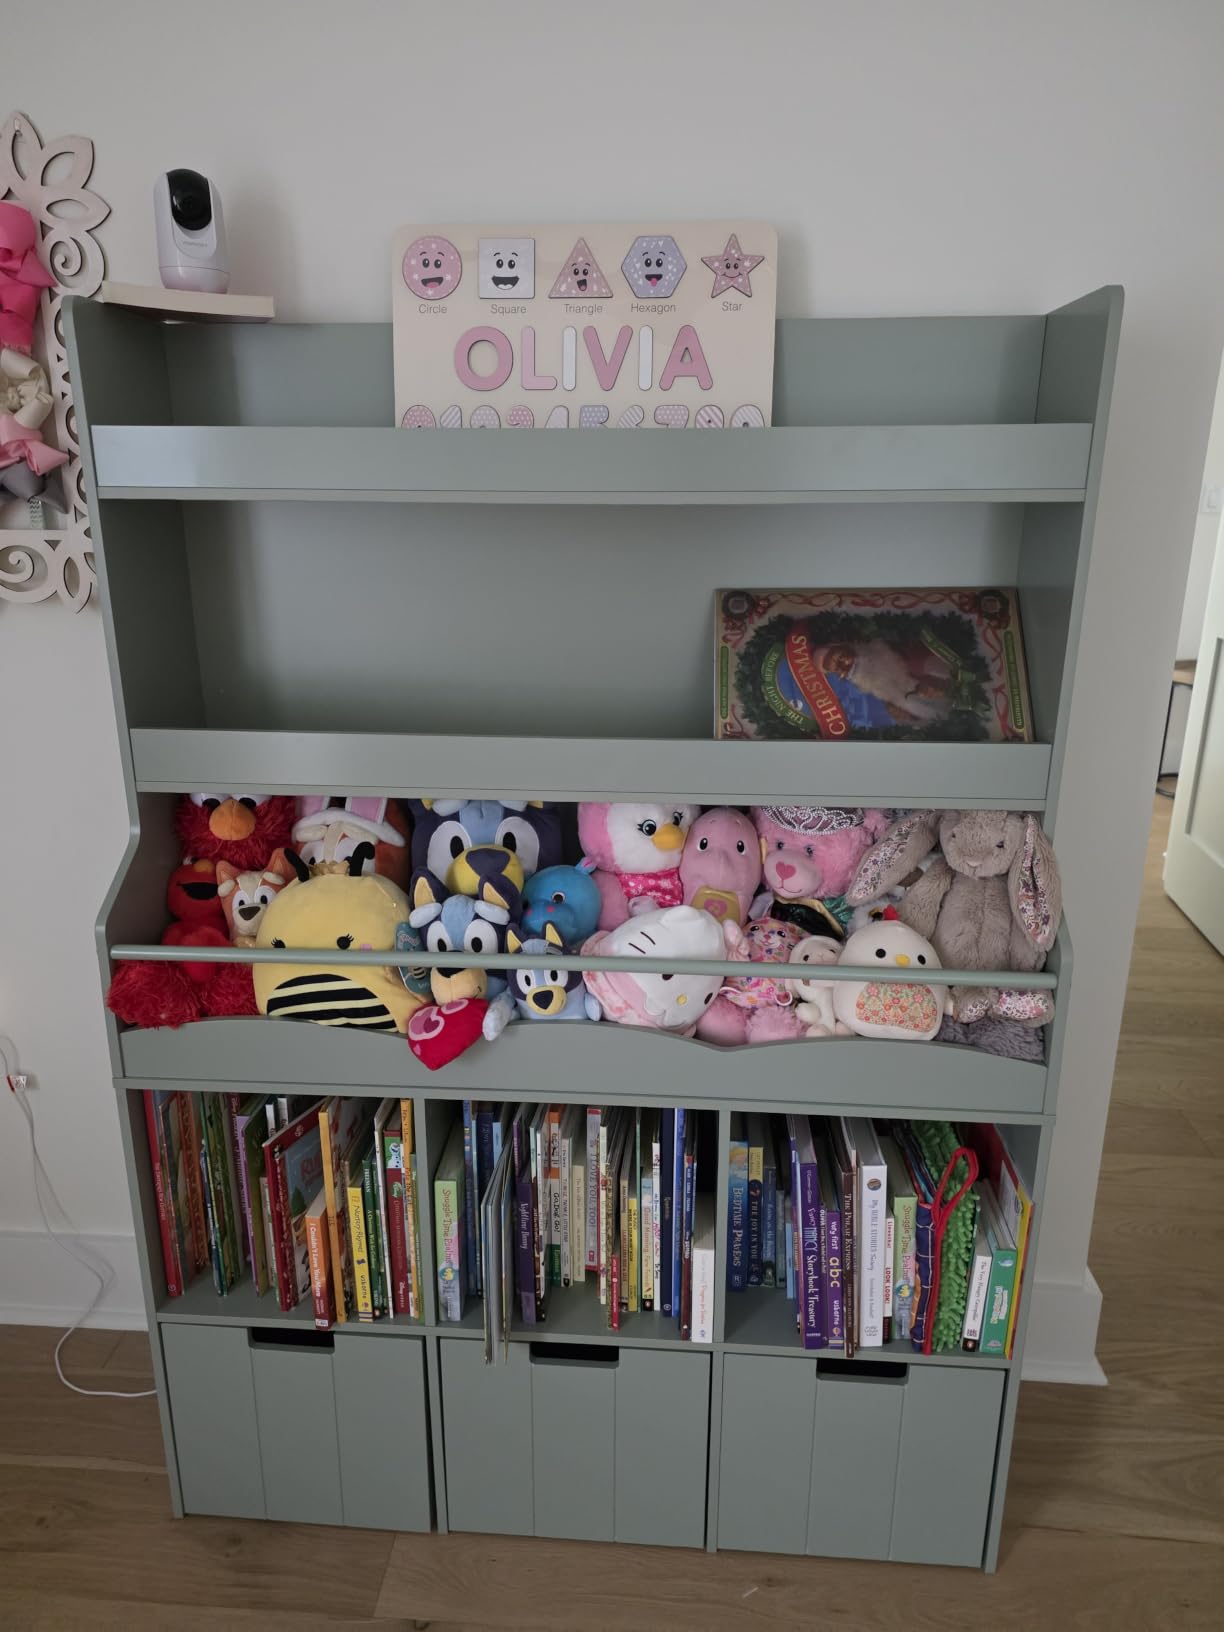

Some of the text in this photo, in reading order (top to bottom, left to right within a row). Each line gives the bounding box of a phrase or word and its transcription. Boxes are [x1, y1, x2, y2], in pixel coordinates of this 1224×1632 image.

[418, 303, 447, 314] Circle
[490, 303, 526, 316] Square
[563, 303, 603, 315] Triangle
[631, 303, 677, 315] Hexagon
[721, 301, 742, 312] Star
[454, 324, 714, 392] OLIVIA
[791, 634, 846, 735] CHRISTMAS
[766, 685, 785, 711] NIGHT
[785, 709, 804, 725] THE
[843, 1193, 851, 1209] THE
[588, 1206, 596, 1226] TOO!
[844, 1211, 852, 1236] POLAR
[870, 1209, 878, 1226] BIBLE
[352, 1204, 364, 1252] Nursery Rhymes
[439, 1188, 454, 1263] Snuggle Time Psalms
[731, 1186, 743, 1266] BEDTIME PRAYERS
[829, 1221, 838, 1234] very
[308, 1226, 318, 1253] Couldn't
[901, 1204, 912, 1280] Snuggle Time Psalms
[311, 1253, 319, 1267] Love
[803, 1207, 820, 1327] Fancy NANCY Storybook Treasury
[313, 1268, 321, 1280] You
[314, 1280, 322, 1296] More
[360, 1274, 368, 1298] usborne
